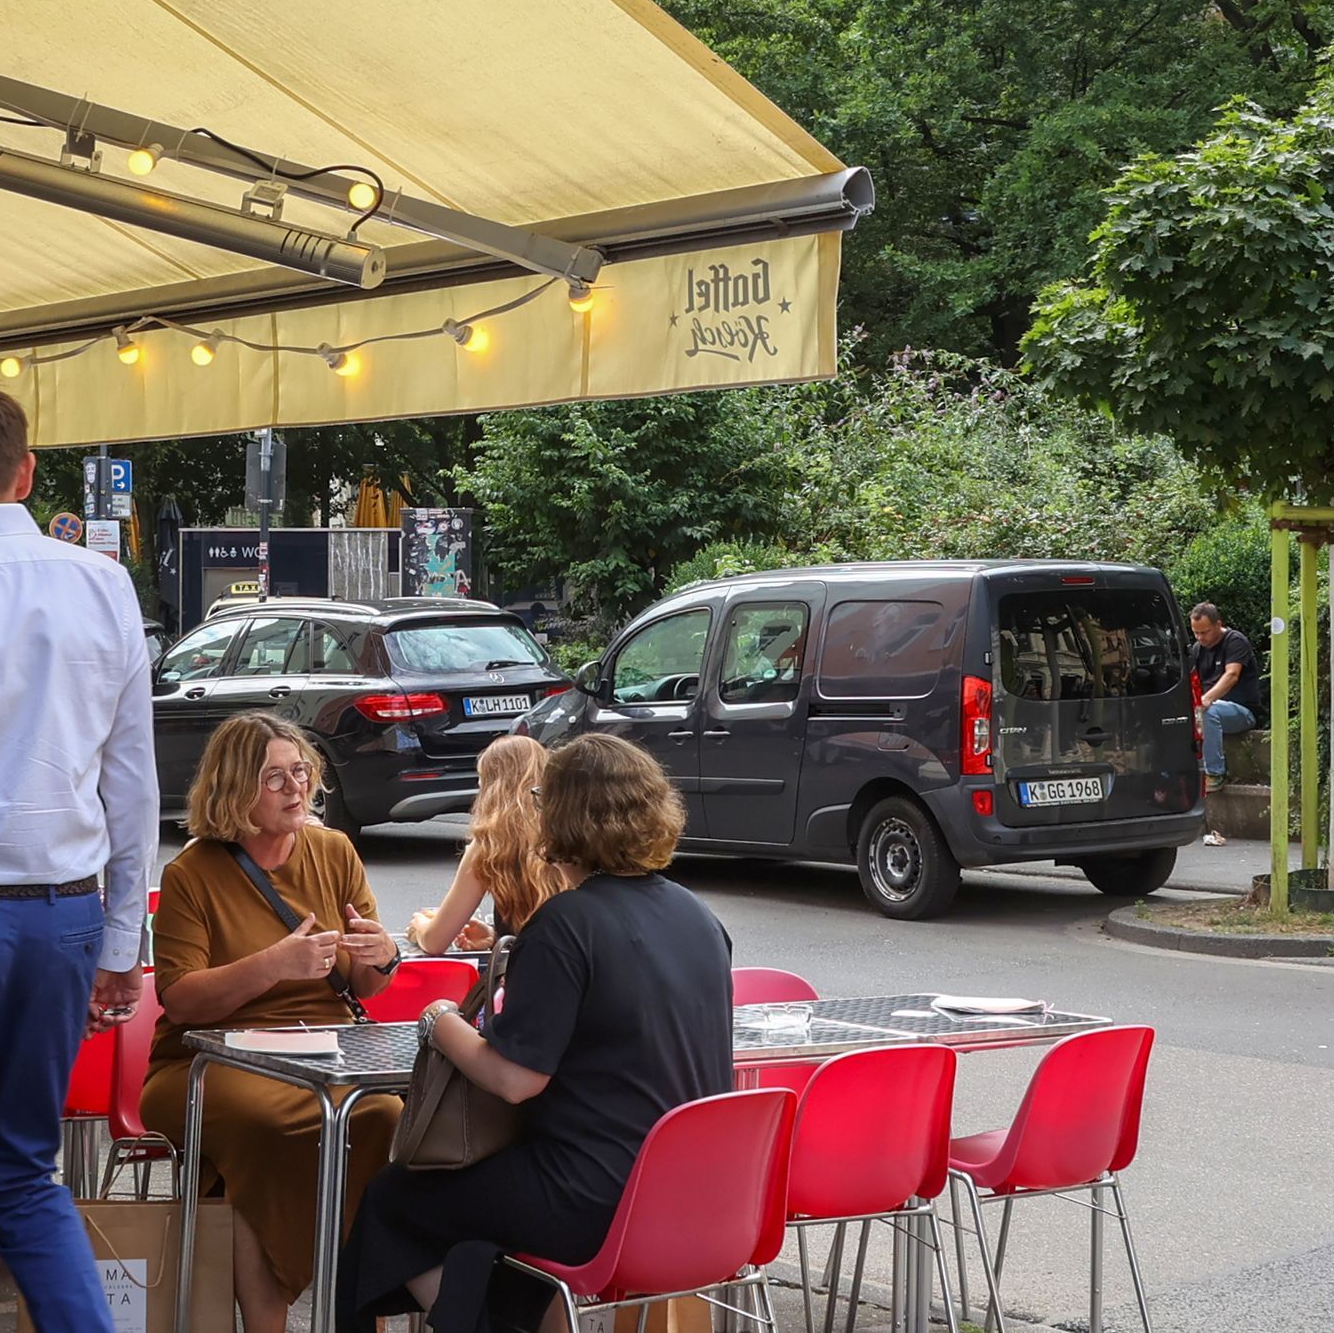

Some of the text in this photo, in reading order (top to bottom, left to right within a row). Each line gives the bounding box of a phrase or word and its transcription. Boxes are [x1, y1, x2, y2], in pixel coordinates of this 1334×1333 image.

[471, 697, 529, 713] K LH 1101
[1028, 780, 1100, 801] K GG 1968
